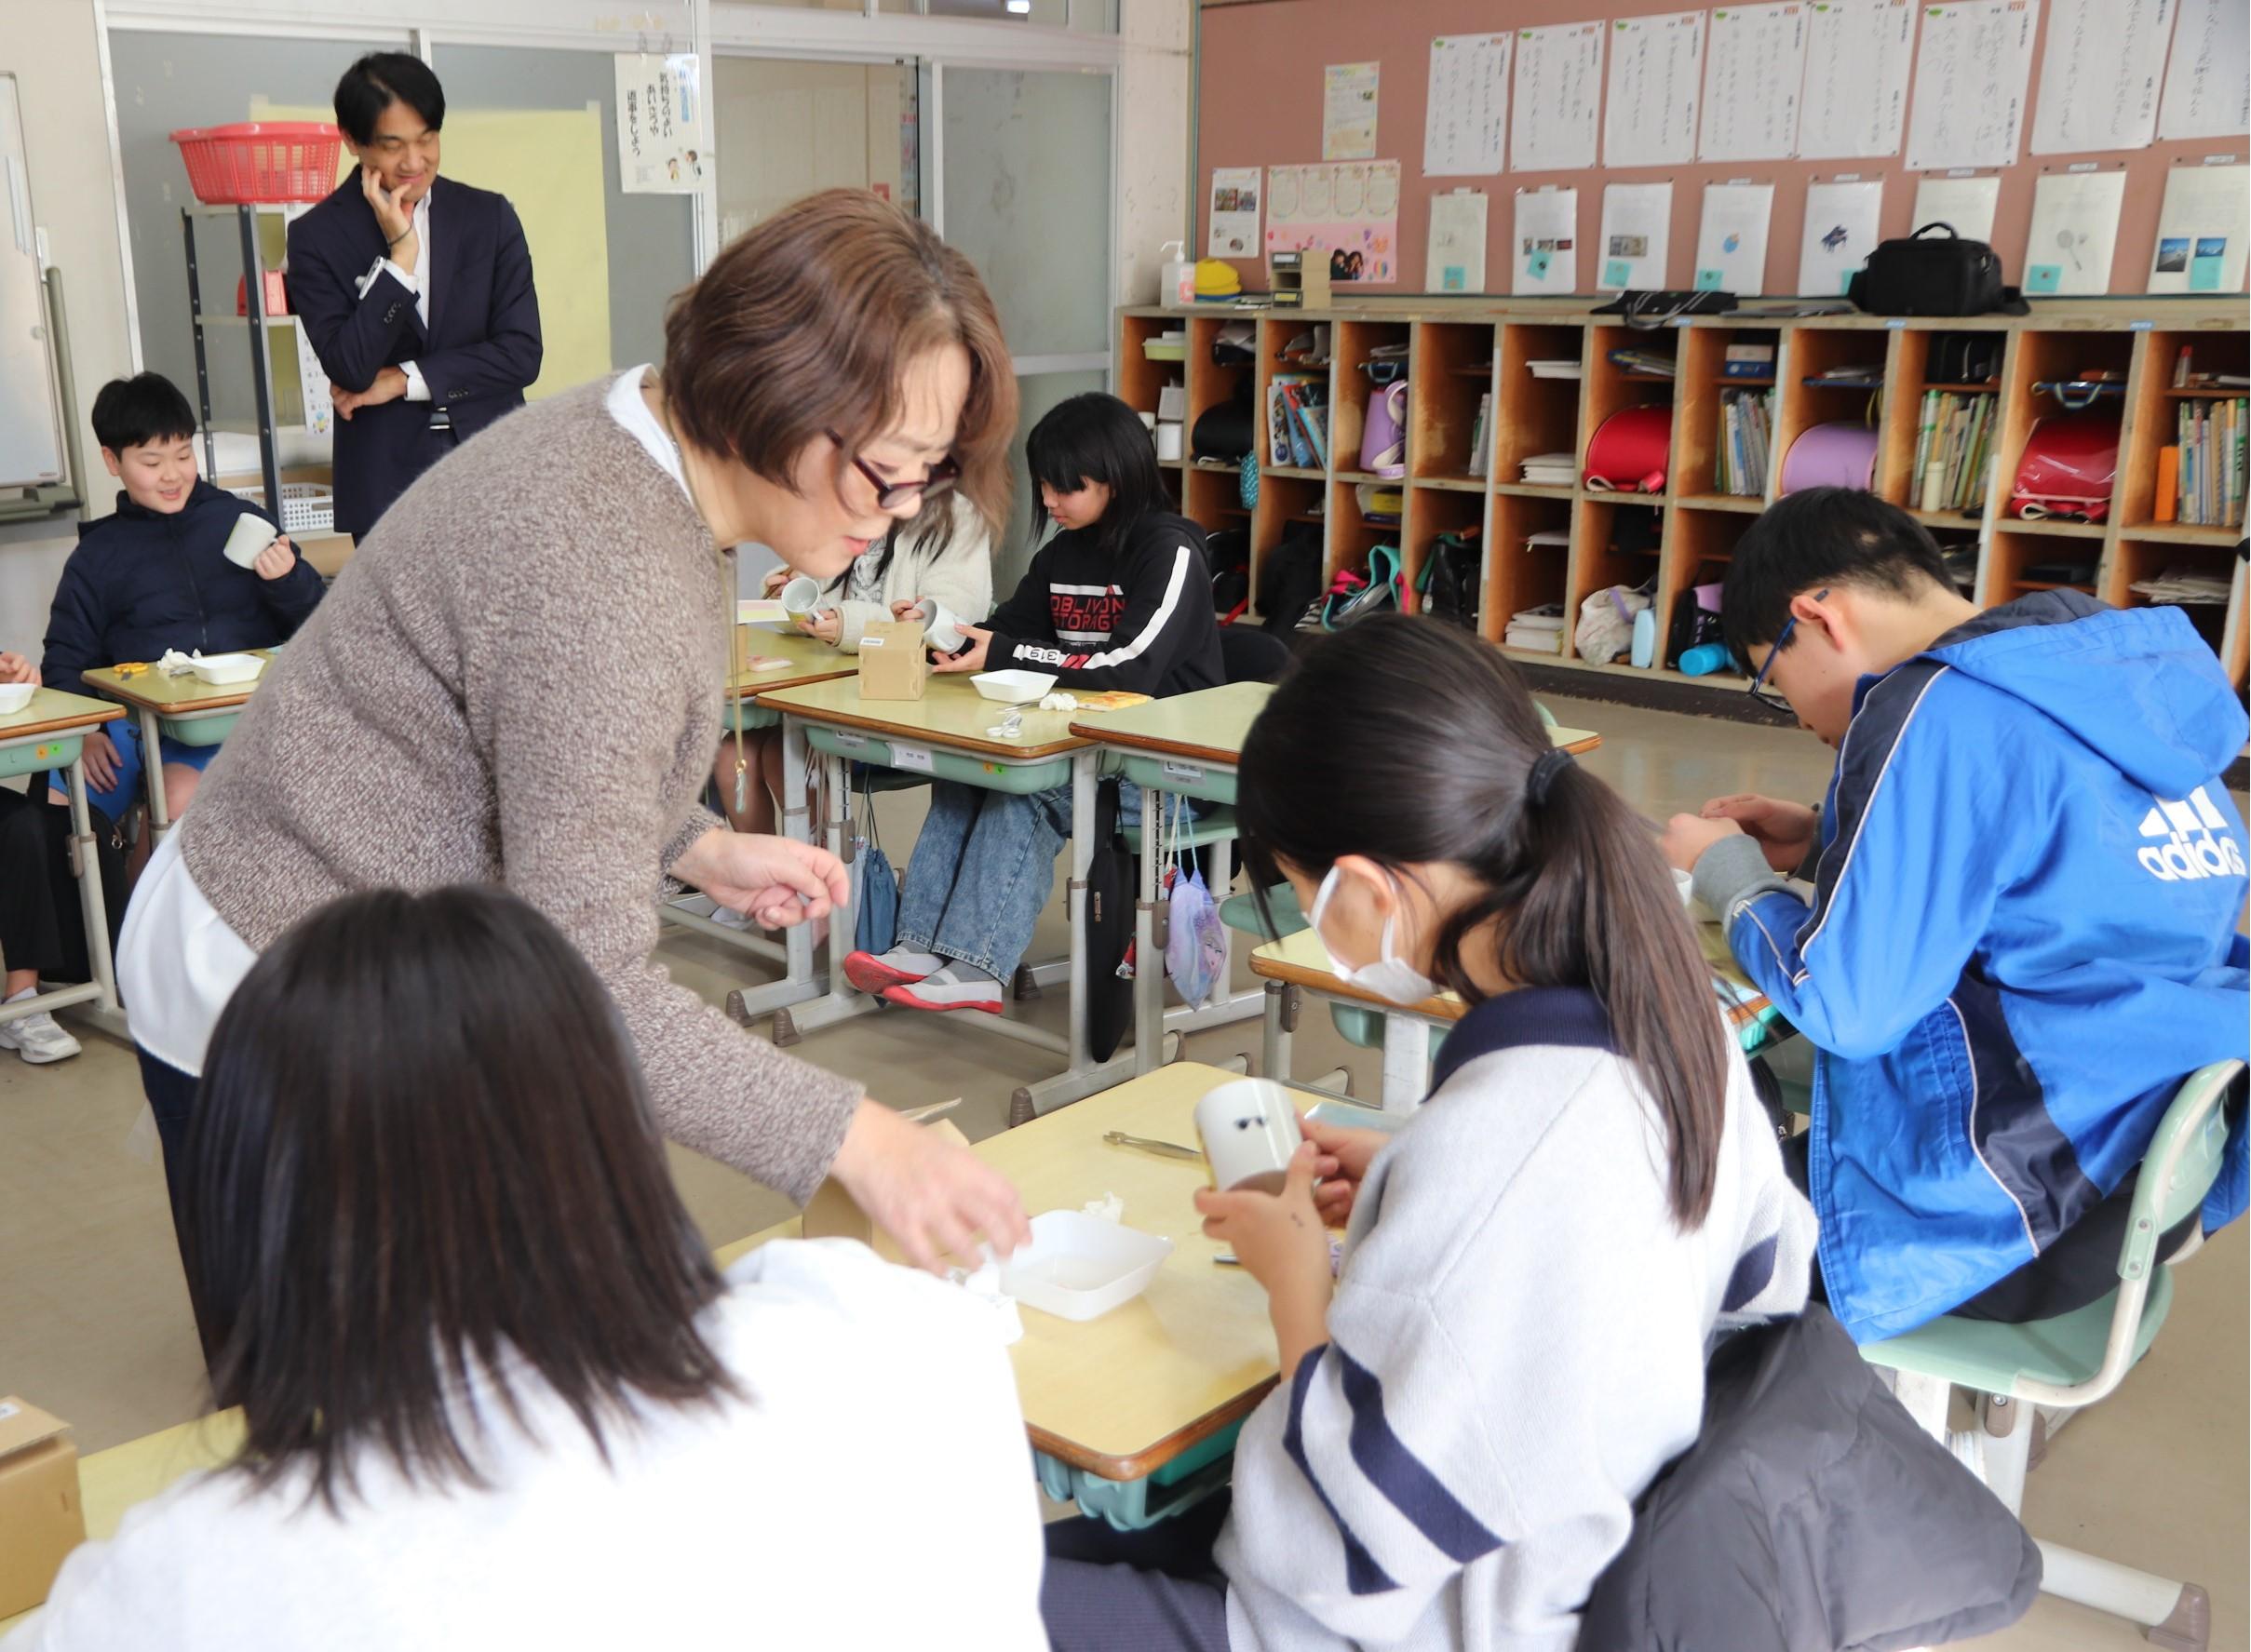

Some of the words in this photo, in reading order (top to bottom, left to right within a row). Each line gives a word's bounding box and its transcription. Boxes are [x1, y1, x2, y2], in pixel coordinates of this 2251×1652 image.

[627, 89, 640, 156] 返事をしよう
[659, 72, 672, 138] 気持ちのよい
[1030, 649, 1058, 661] 319
